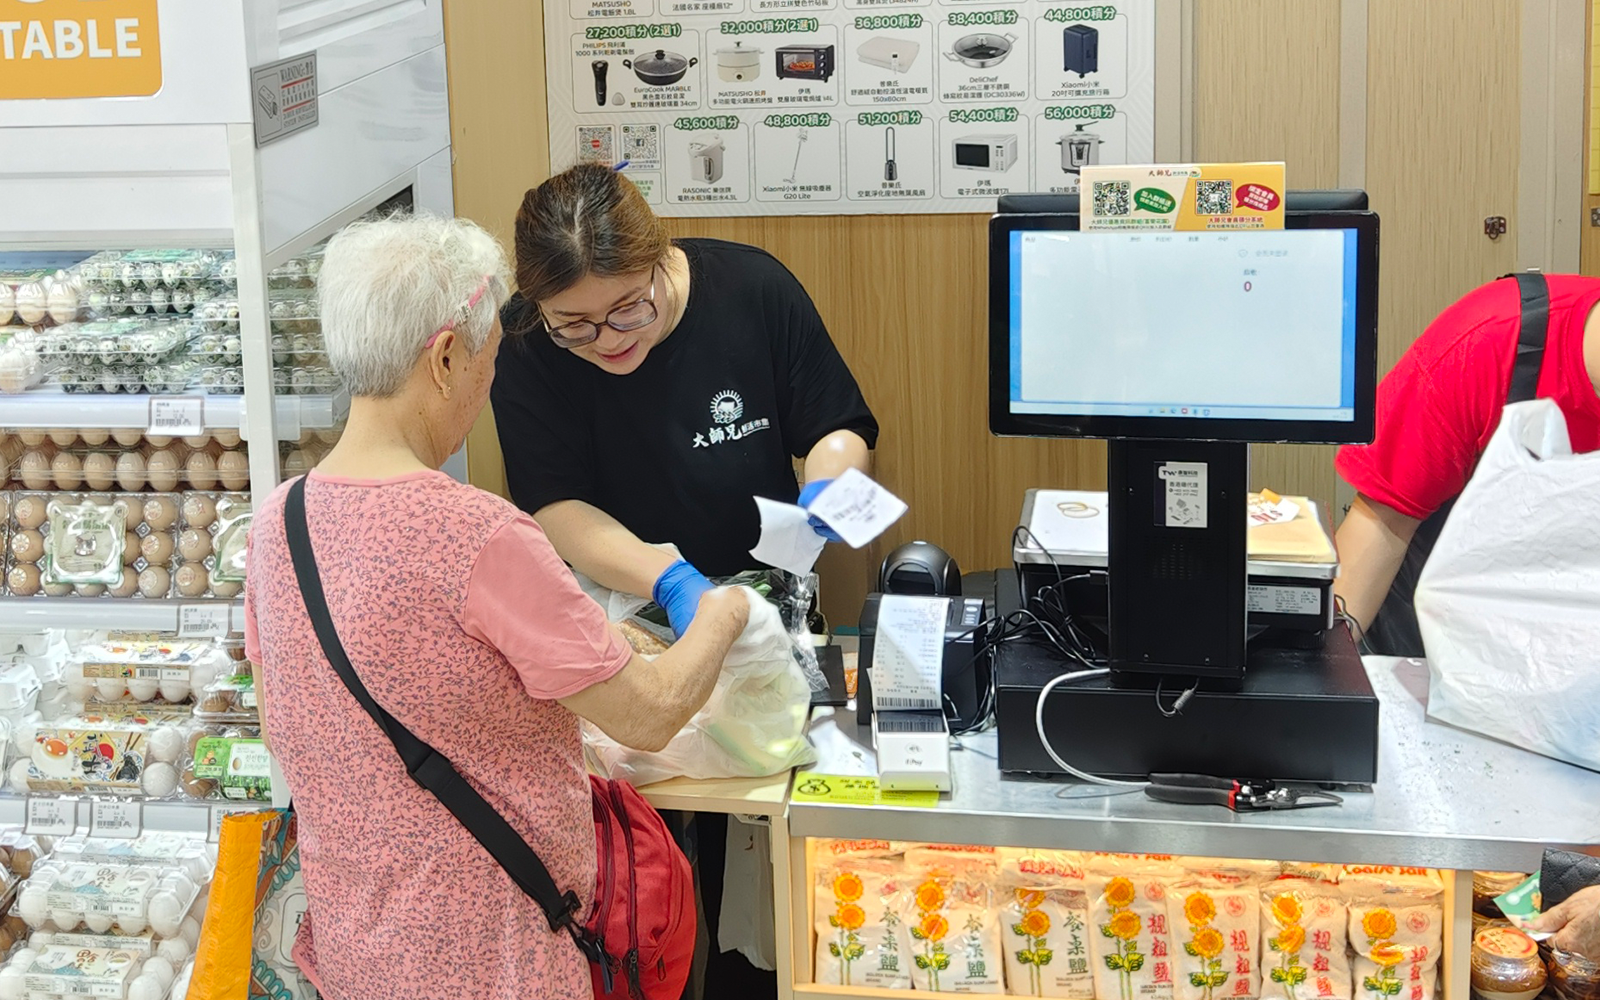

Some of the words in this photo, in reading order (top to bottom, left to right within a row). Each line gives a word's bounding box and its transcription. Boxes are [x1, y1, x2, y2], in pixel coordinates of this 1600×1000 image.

[855, 14, 922, 29] 36,800積分
[949, 10, 1018, 25] 38,400積分
[1045, 6, 1116, 22] 44,800積分
[765, 113, 831, 127] 48,800積分
[858, 110, 922, 125] 51,200積分
[949, 108, 1019, 122] 54,400積分
[1045, 105, 1116, 120] 56,000積分
[674, 116, 739, 130] 45,600積分
[1244, 281, 1252, 292] 0
[692, 423, 743, 449] 大師兄
